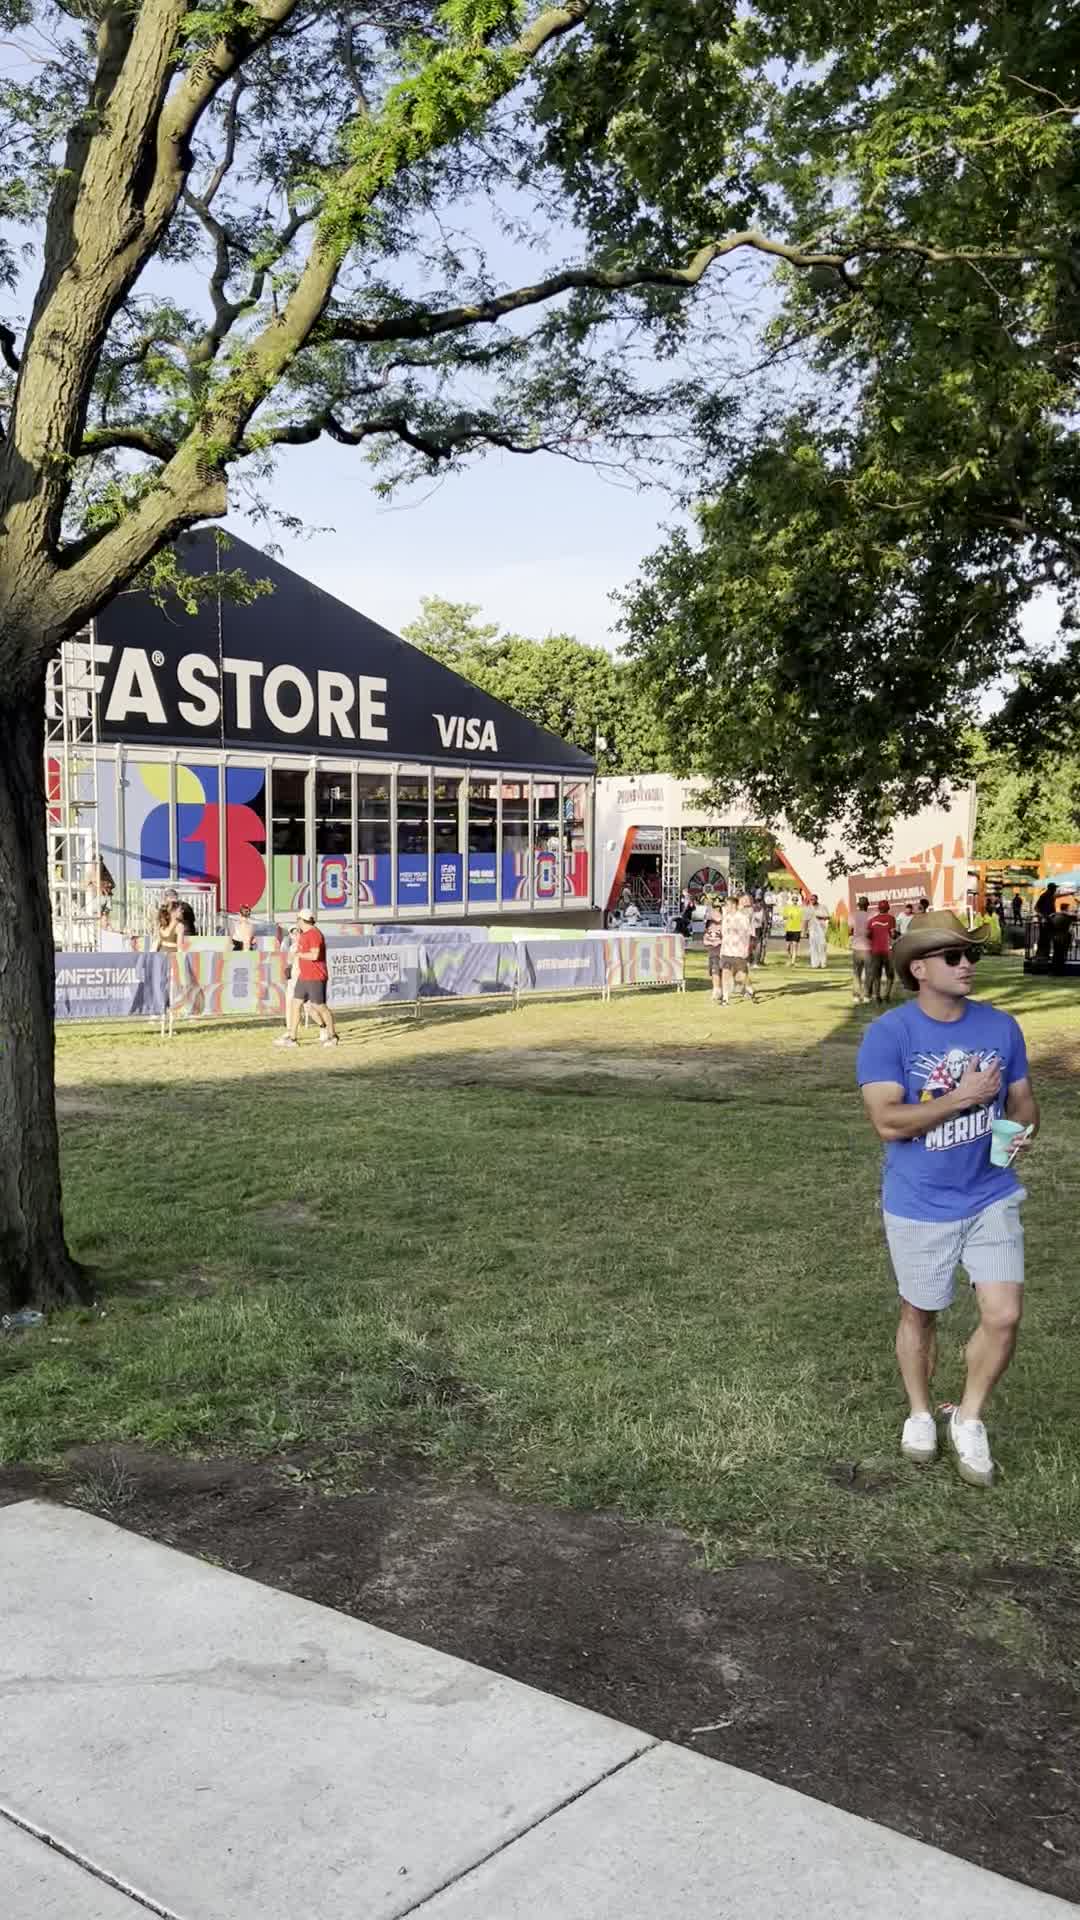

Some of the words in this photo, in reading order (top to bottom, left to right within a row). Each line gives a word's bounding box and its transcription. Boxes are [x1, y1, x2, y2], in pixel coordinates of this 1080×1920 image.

[176, 653, 389, 742] STORE
[432, 713, 499, 752] VISA
[332, 952, 398, 965] WELCOMING
[332, 964, 348, 976] THE
[348, 963, 377, 974] WORLD
[378, 962, 399, 972] WITH
[331, 973, 397, 985] PHILLY
